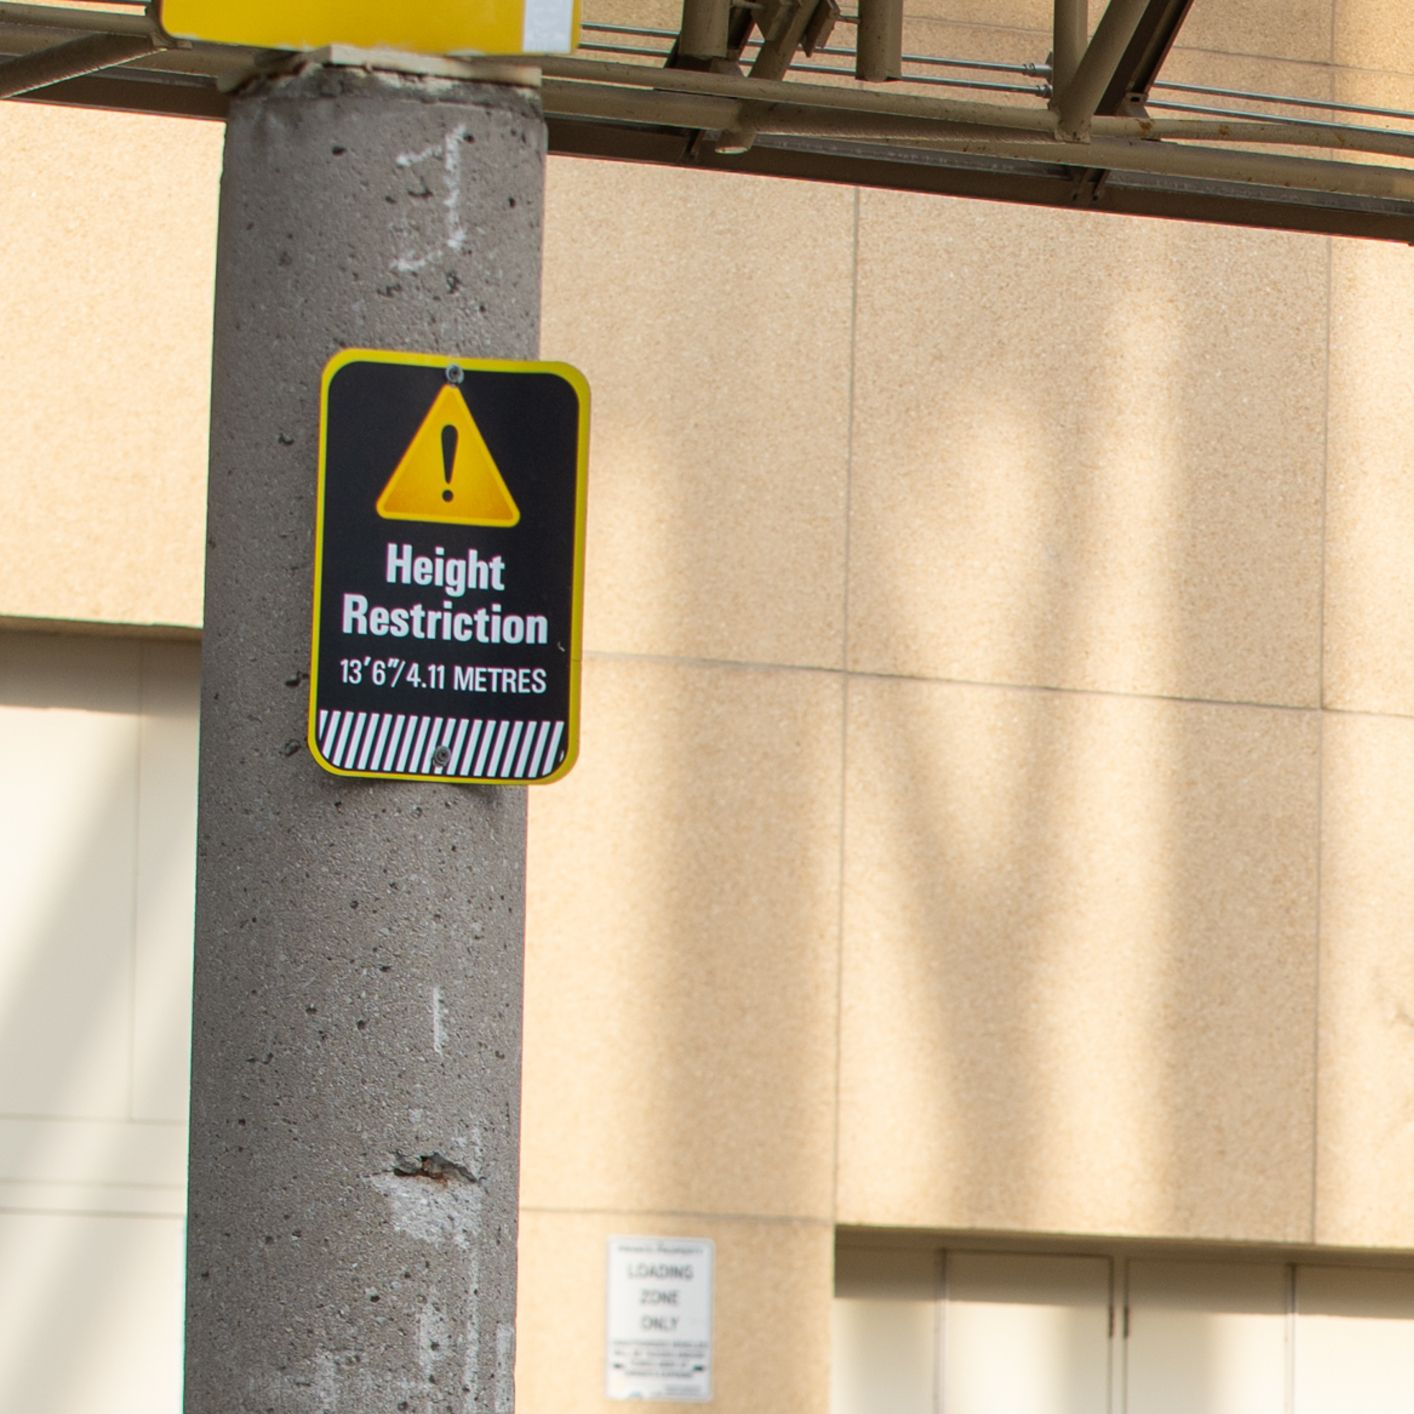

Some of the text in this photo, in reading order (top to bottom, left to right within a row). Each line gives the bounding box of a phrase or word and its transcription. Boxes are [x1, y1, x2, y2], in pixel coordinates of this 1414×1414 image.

[386, 542, 505, 597] Height
[342, 593, 548, 644] Restriction
[453, 665, 547, 694] METRES
[626, 1263, 694, 1281] LOADING
[641, 1289, 679, 1305] ZONE
[640, 1315, 679, 1332] ONLY
